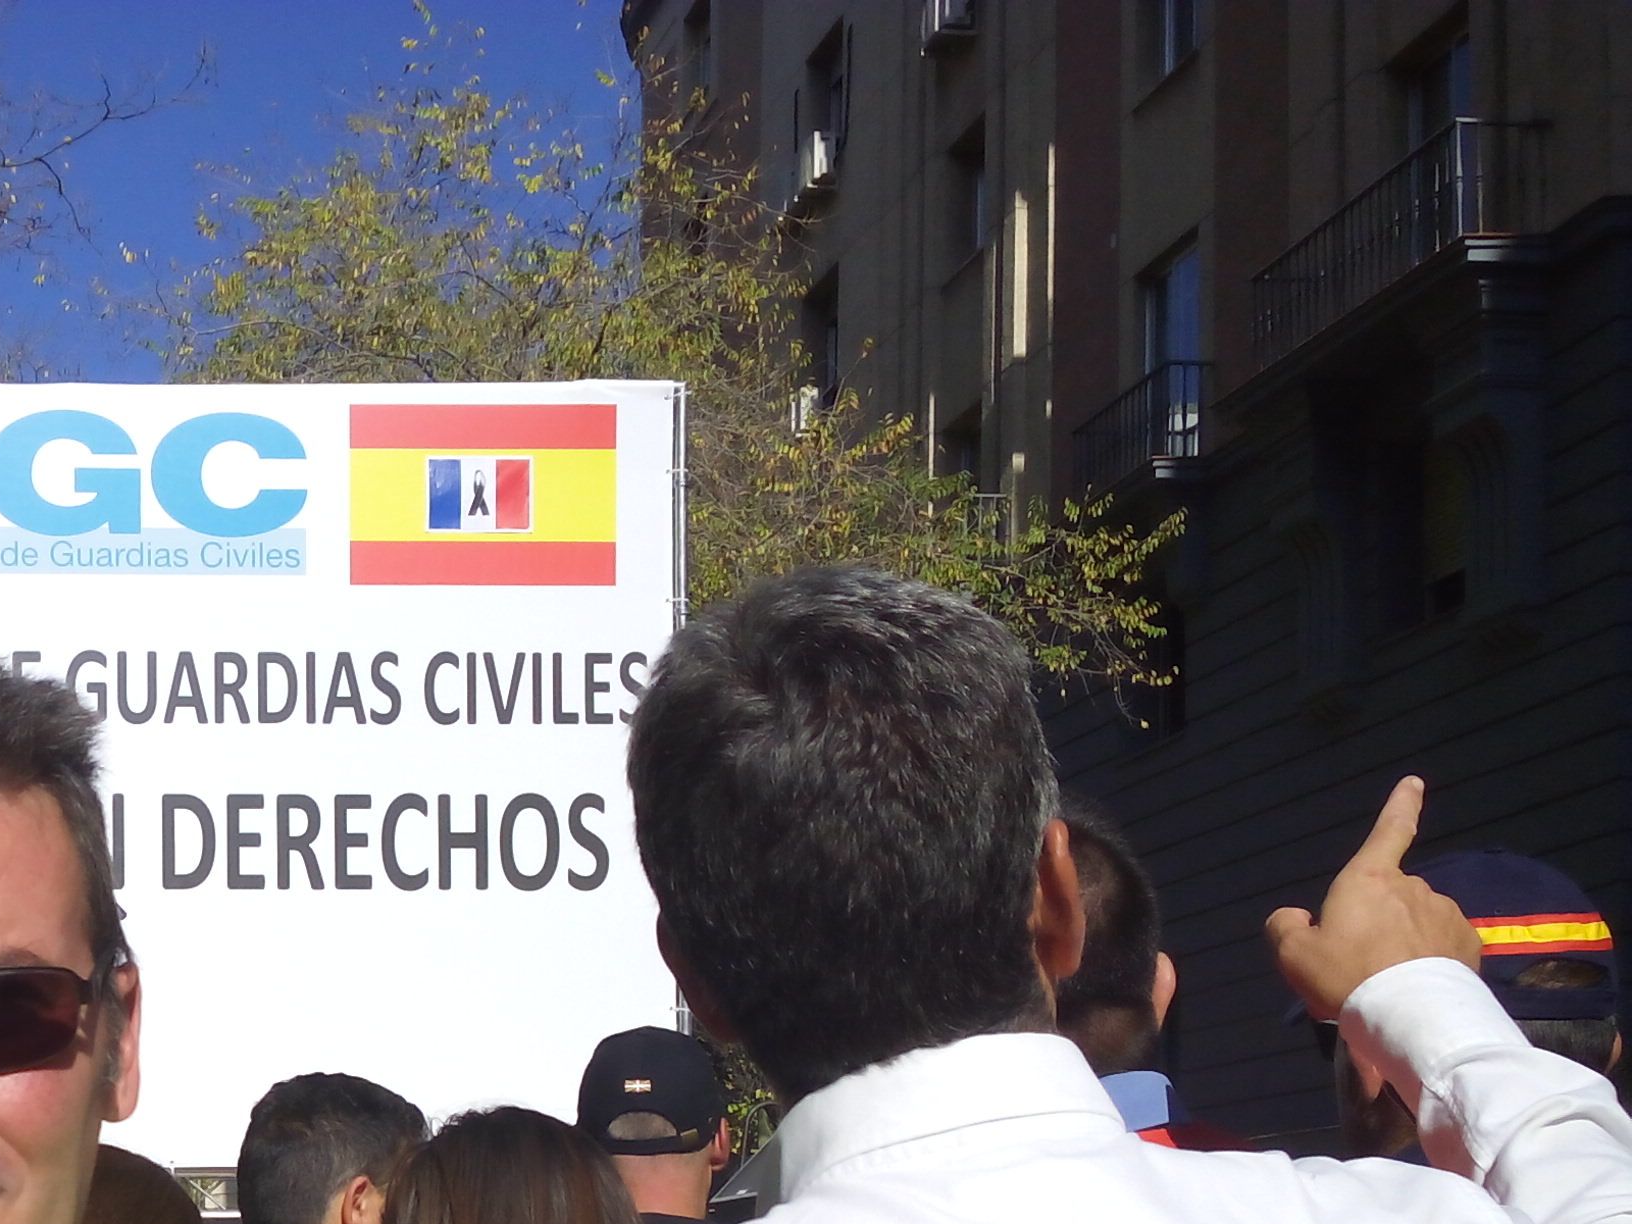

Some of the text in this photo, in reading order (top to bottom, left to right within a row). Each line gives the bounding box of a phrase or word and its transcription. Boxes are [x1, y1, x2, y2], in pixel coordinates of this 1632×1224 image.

[0, 541, 39, 568] de
[50, 541, 189, 569] Guardias
[200, 542, 301, 569] Civiles
[66, 649, 402, 725] GUARDIAS
[424, 651, 648, 726] CIVILES
[162, 792, 610, 892] DERECHOS
